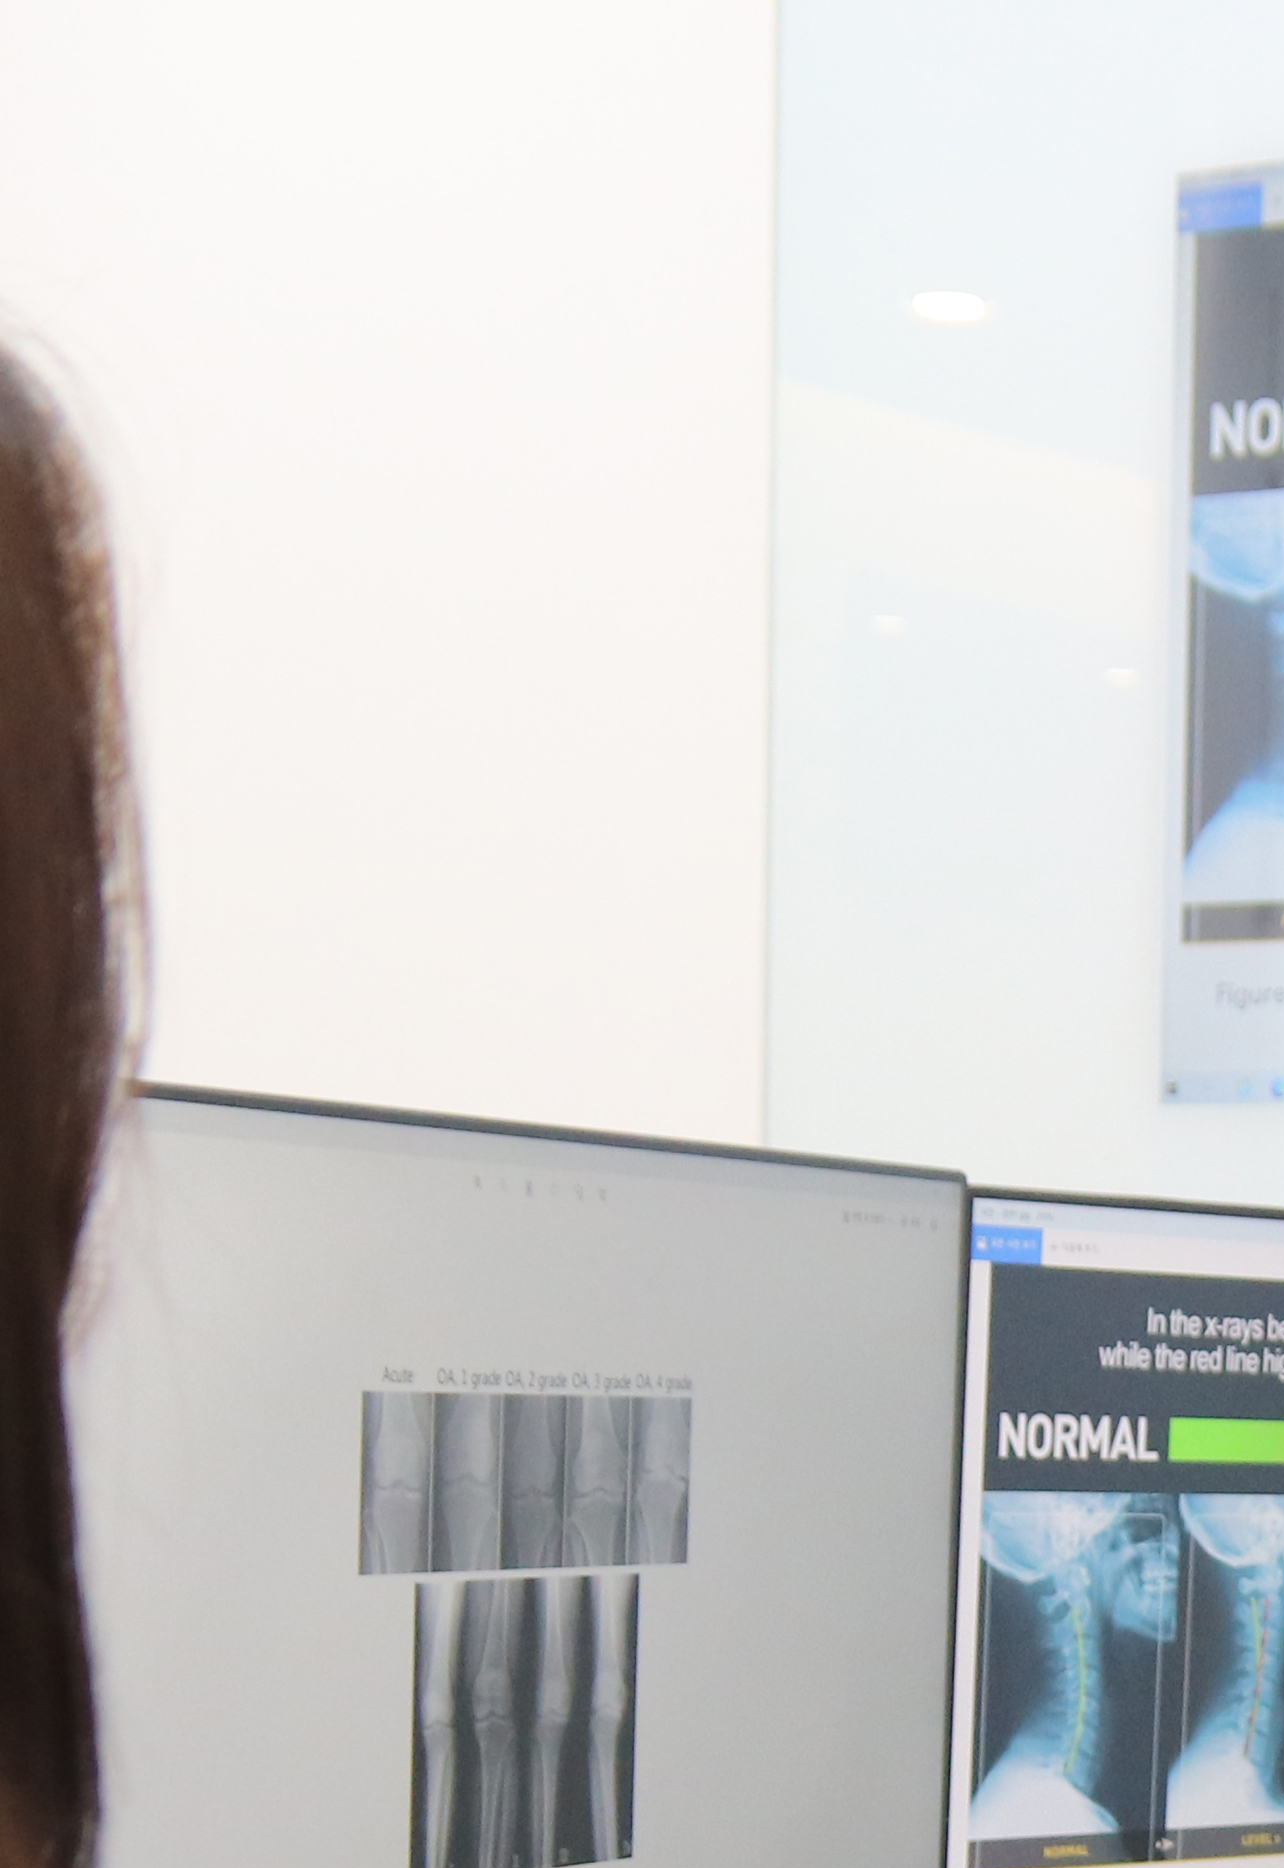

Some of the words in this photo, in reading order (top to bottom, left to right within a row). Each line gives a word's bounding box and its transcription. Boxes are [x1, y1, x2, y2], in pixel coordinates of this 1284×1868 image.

[1147, 1307, 1167, 1335] In
[1170, 1309, 1200, 1337] the
[1205, 1313, 1264, 1345] x-rays
[1099, 1341, 1150, 1370] while
[1155, 1344, 1187, 1371] the
[1189, 1346, 1223, 1373] red
[1226, 1346, 1260, 1374] line
[381, 1367, 413, 1384] Acute
[471, 1370, 501, 1390] grade
[537, 1372, 567, 1391] grade
[603, 1375, 631, 1392] grade
[666, 1375, 692, 1392] grade
[998, 1412, 1159, 1462] NORMAL
